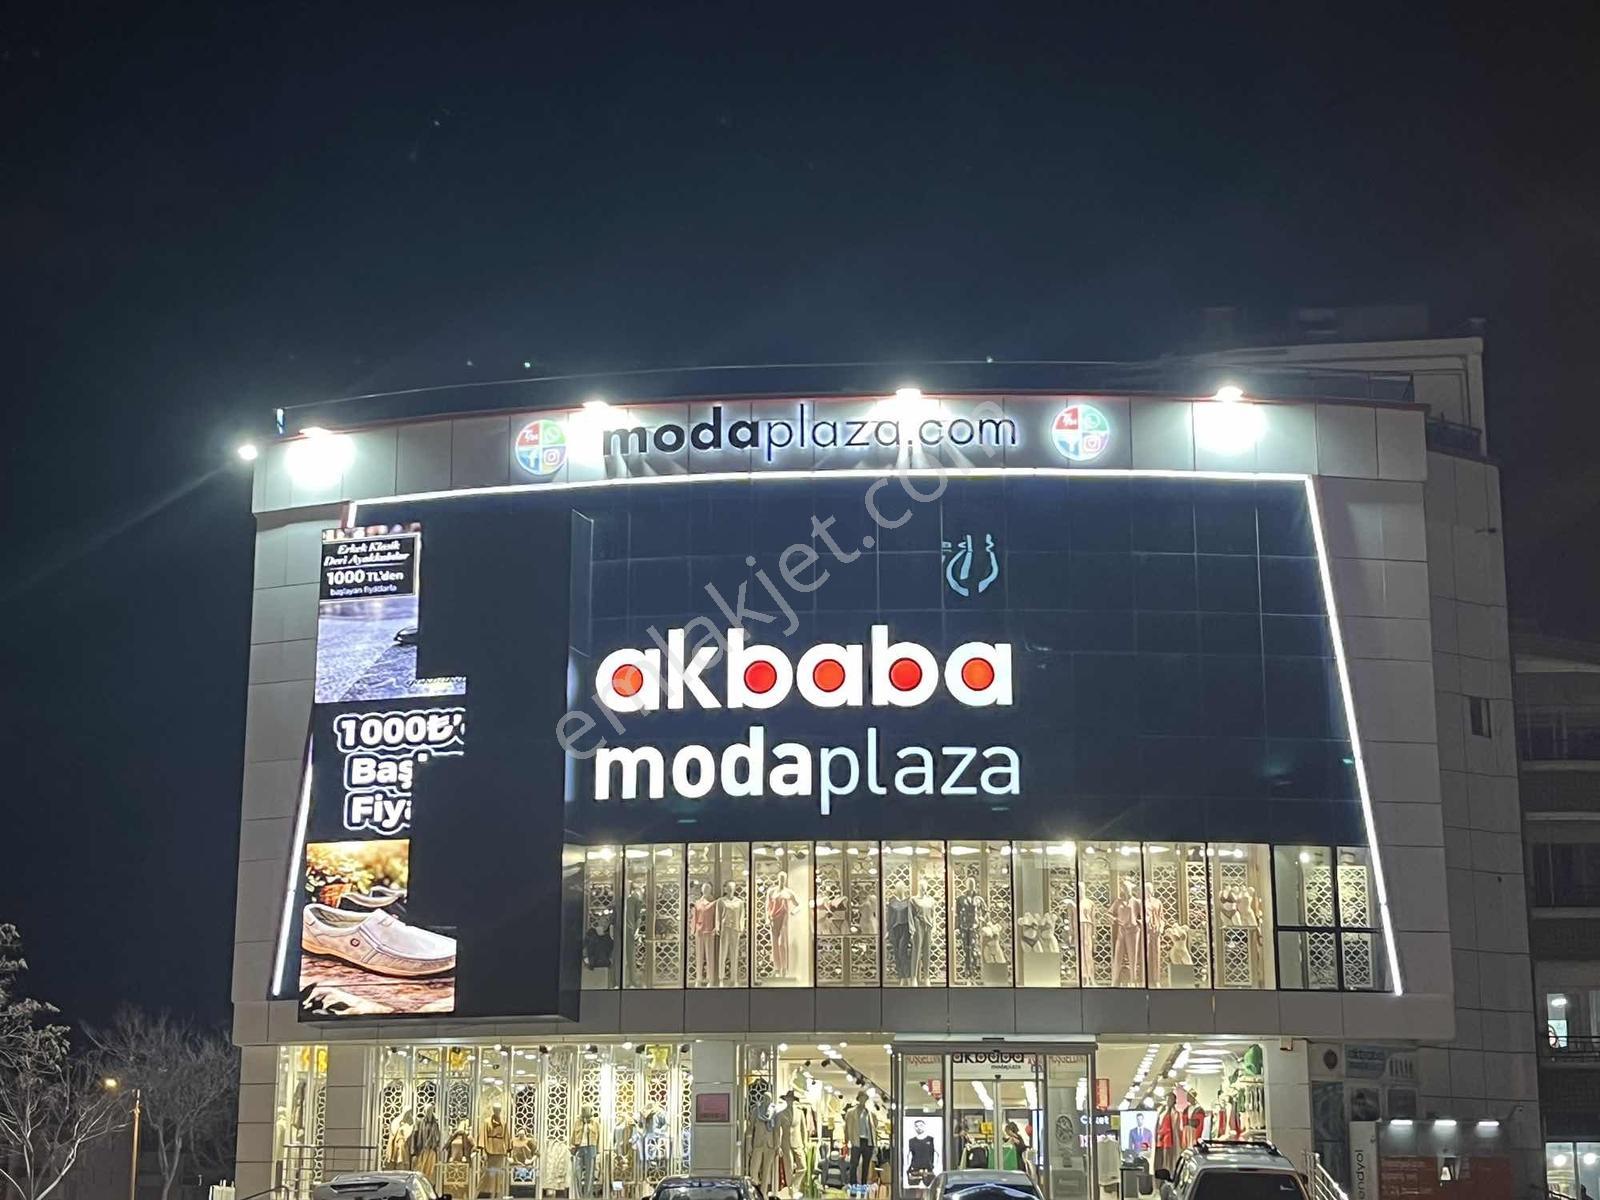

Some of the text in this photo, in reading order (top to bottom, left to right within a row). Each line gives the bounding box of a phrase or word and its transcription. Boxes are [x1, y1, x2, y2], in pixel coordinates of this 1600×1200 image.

[602, 402, 1018, 463] modaplaza.com
[326, 569, 404, 586] 1000 TL'den
[595, 624, 1013, 713] akbaba
[594, 725, 1021, 816] modaplaza
